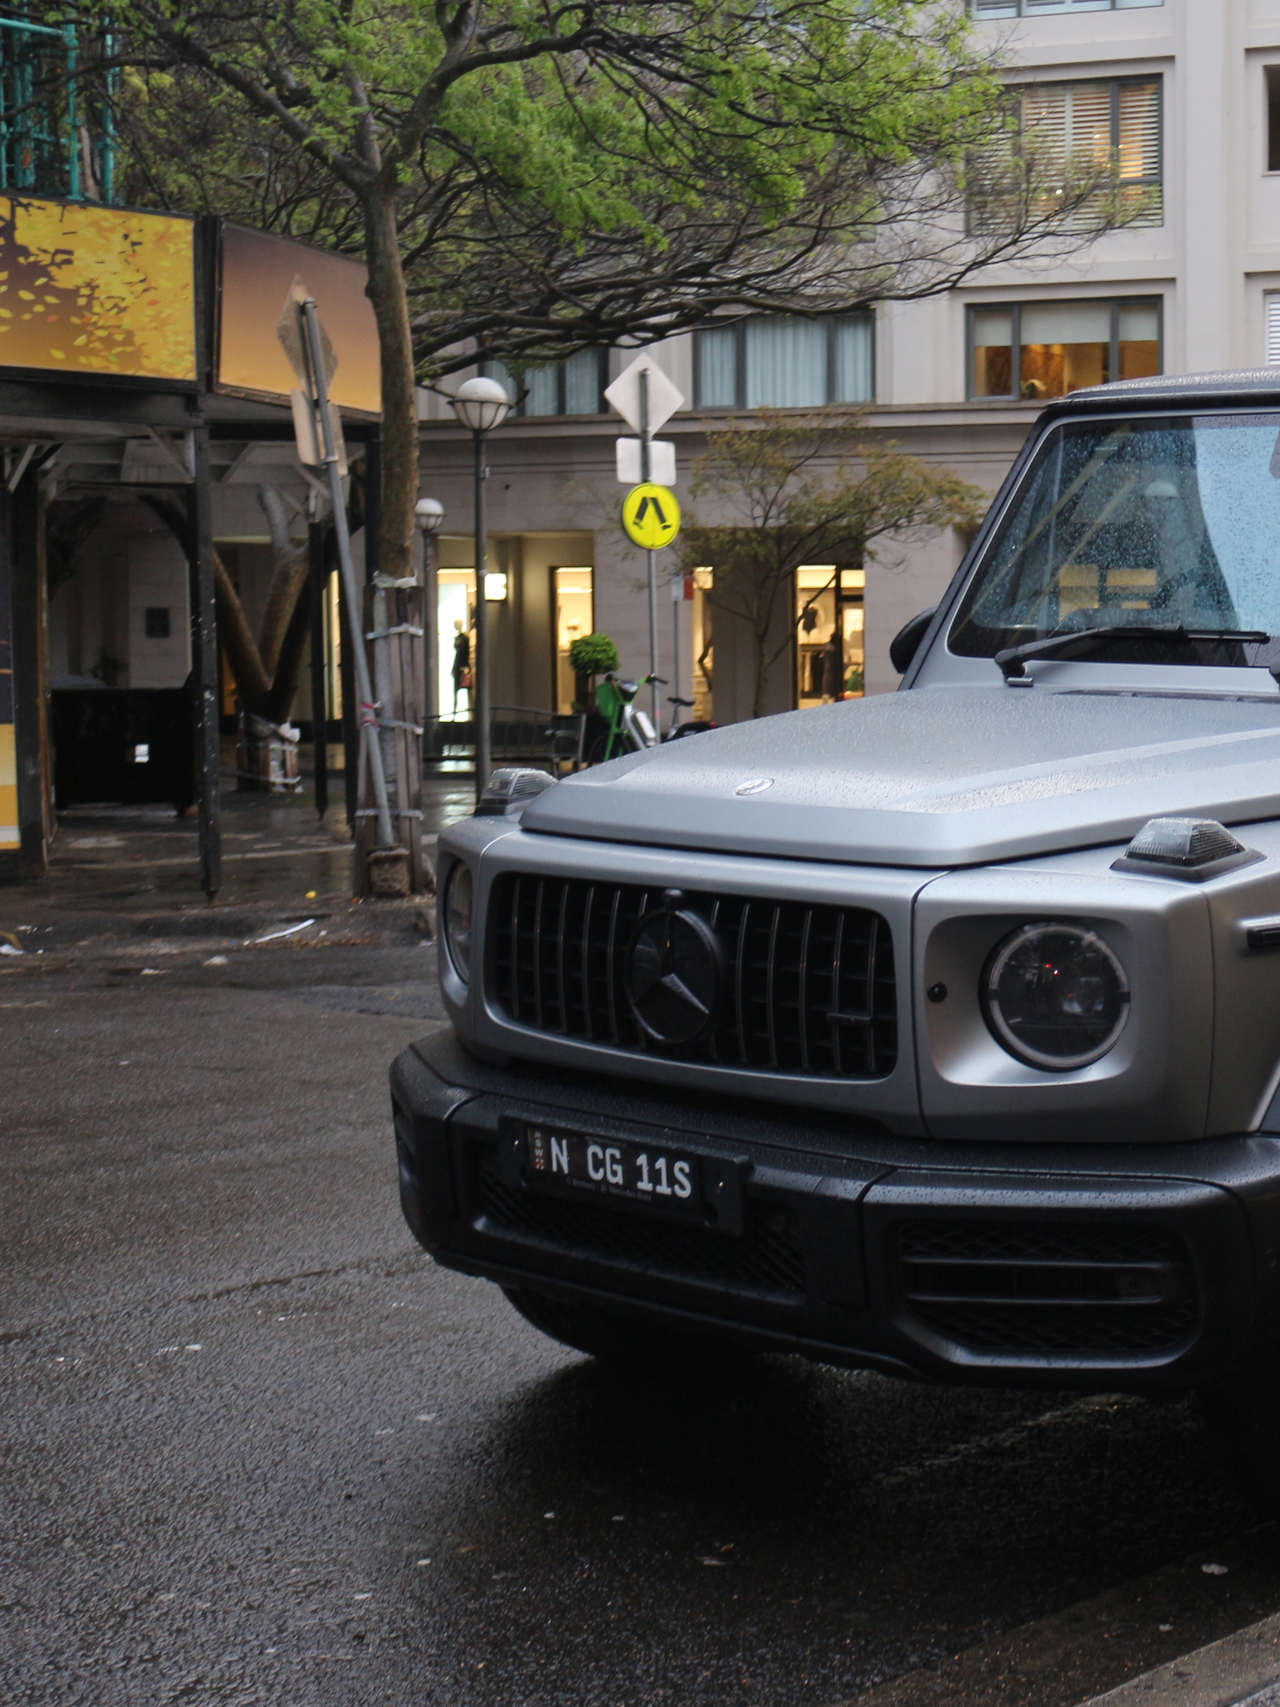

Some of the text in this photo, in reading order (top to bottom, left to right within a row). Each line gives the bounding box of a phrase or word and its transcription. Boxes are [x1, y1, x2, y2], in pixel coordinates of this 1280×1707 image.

[550, 1137, 692, 1198] N CG 11S
